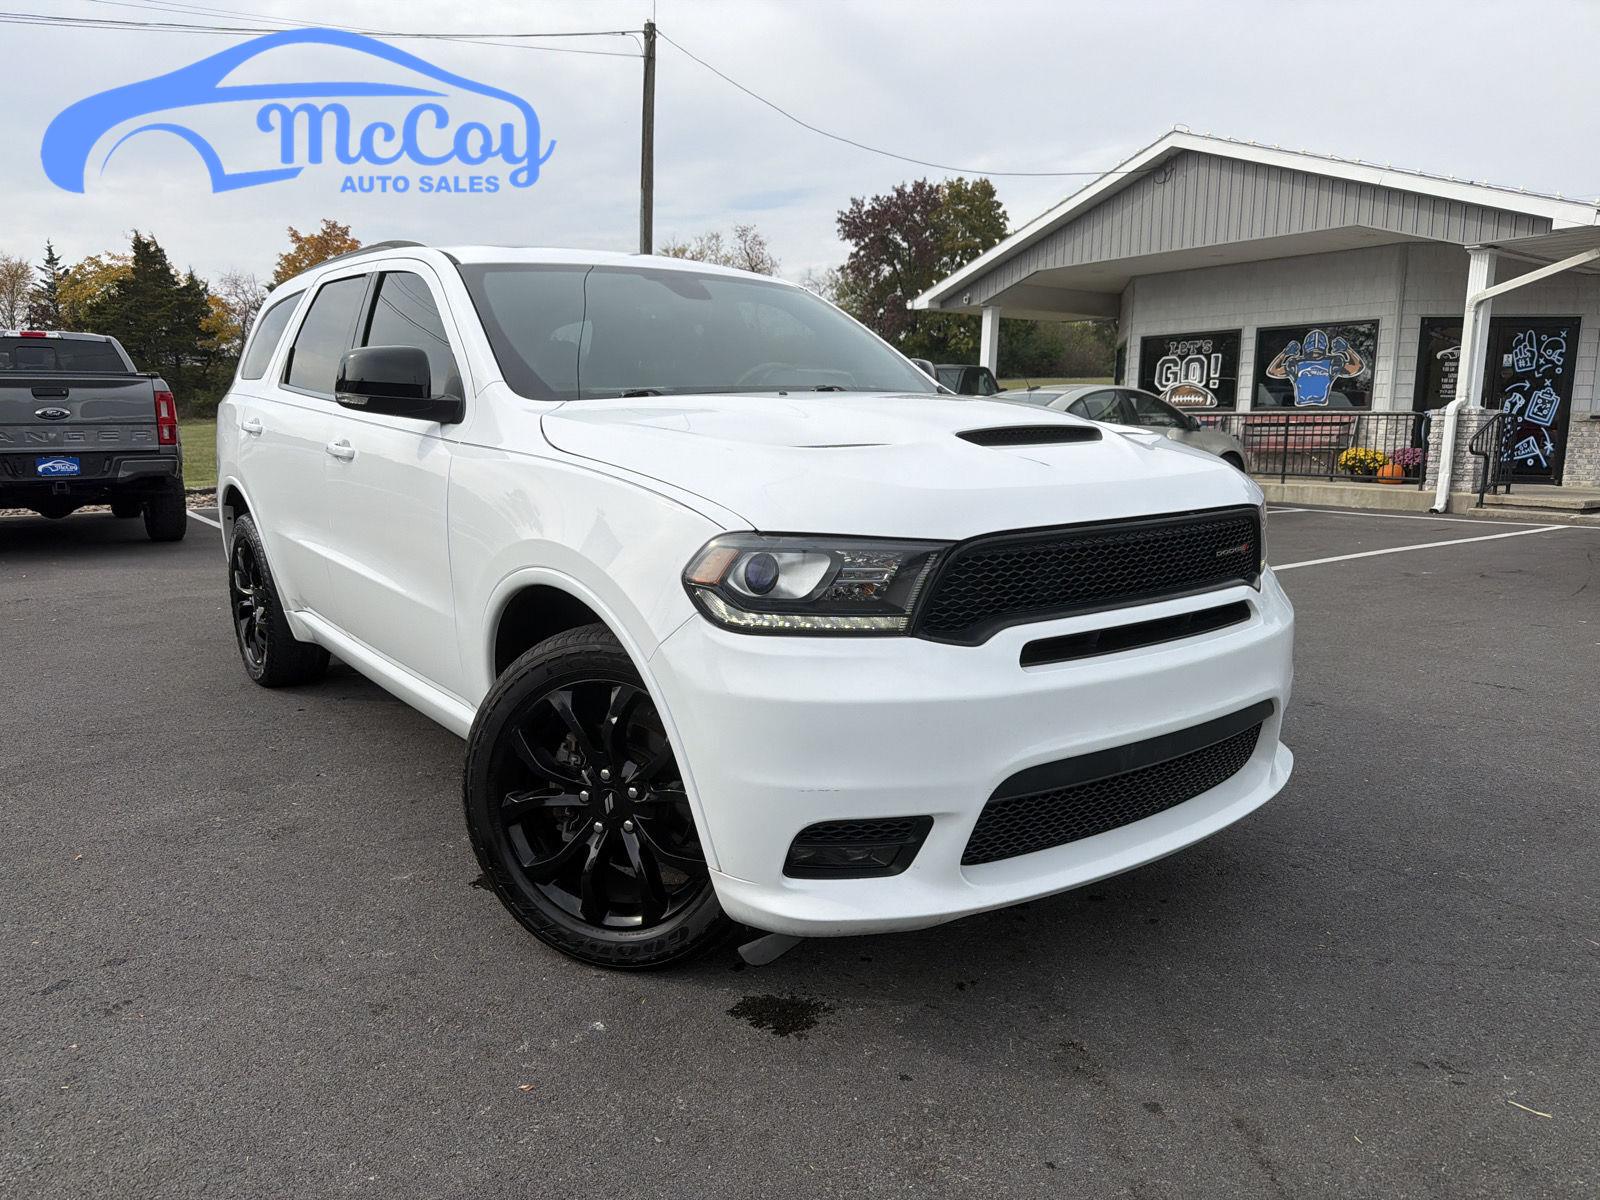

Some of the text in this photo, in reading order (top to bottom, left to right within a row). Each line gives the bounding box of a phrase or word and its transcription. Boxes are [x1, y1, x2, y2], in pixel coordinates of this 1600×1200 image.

[1518, 359, 1531, 367] #1
[1154, 352, 1222, 391] GO!
[1518, 443, 1528, 451] GO
